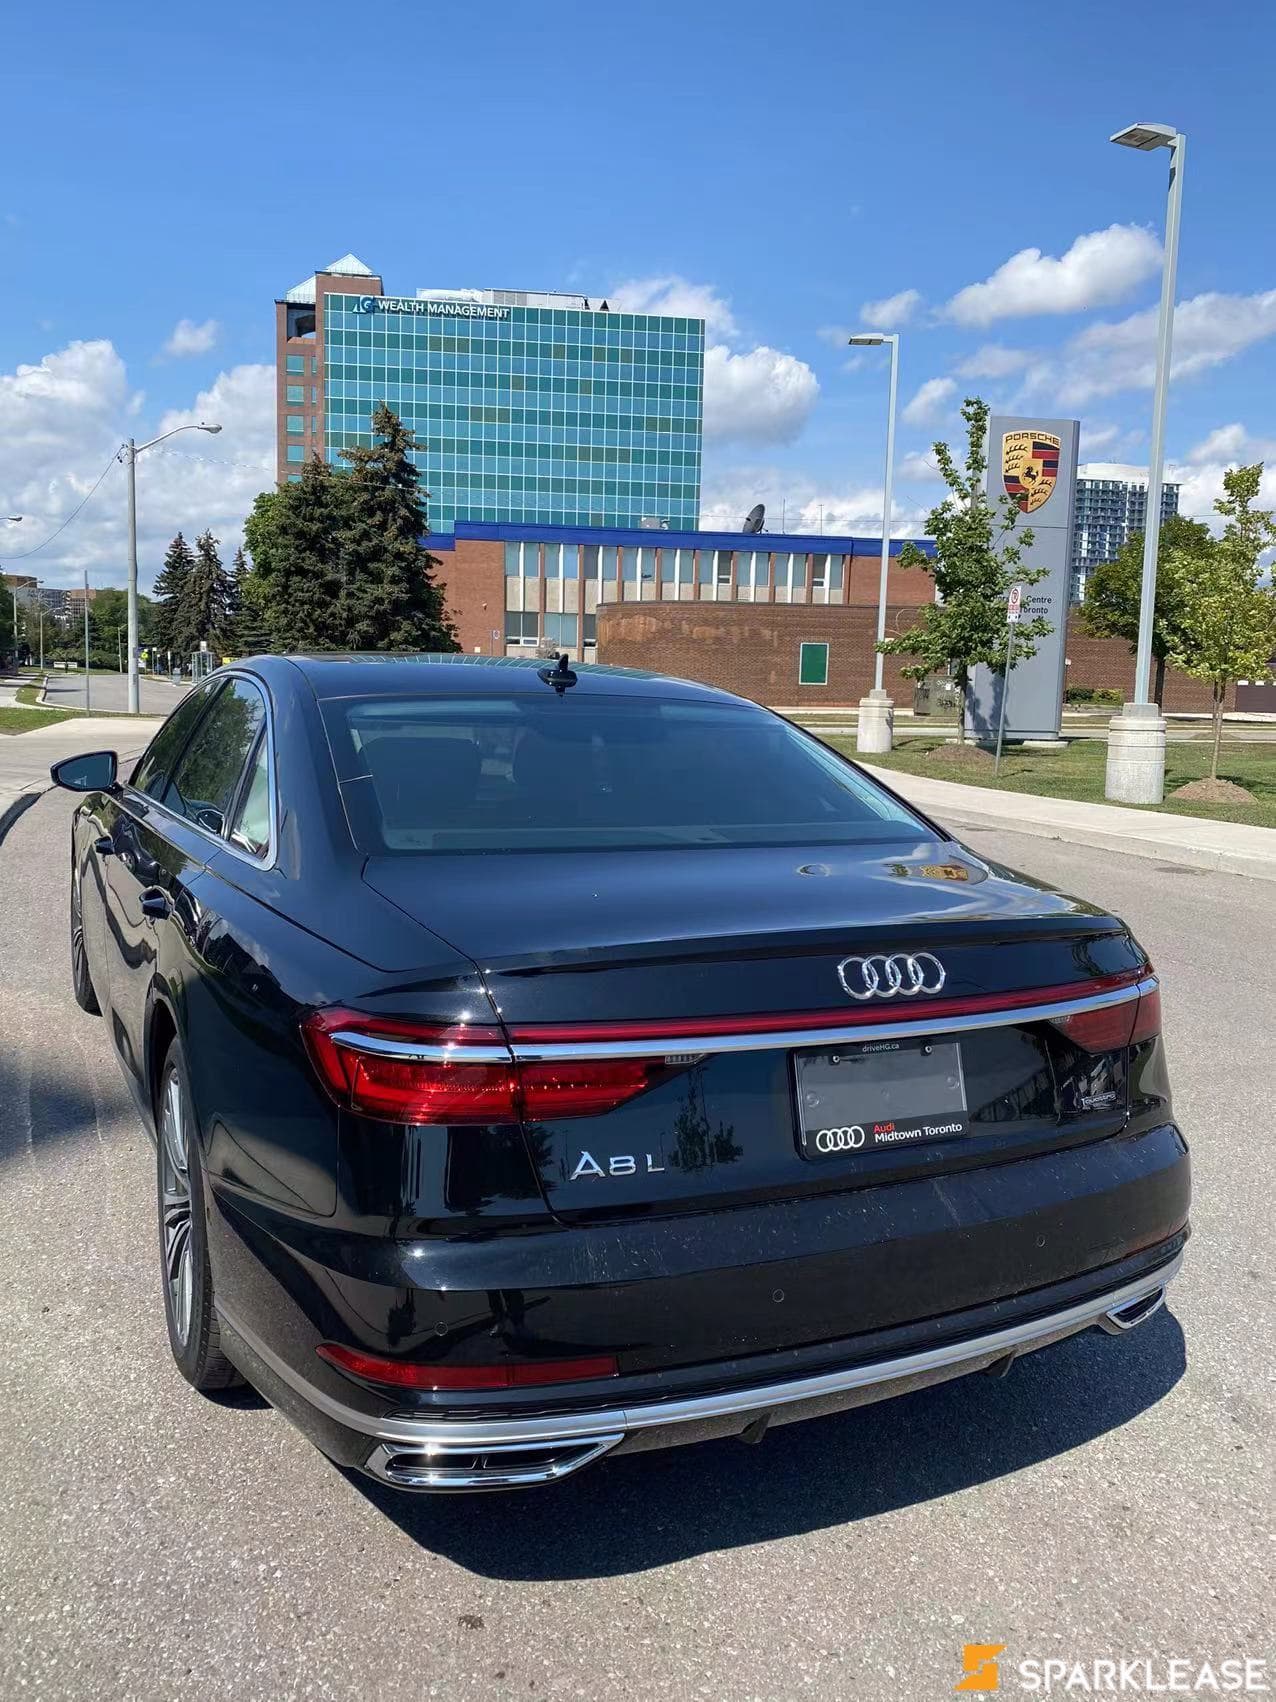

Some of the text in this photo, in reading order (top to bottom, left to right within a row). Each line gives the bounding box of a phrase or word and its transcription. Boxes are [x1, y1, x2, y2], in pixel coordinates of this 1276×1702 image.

[378, 300, 424, 313] WEALTH
[427, 303, 509, 318] MANAGEMENT
[1005, 432, 1060, 446] PORSCHE
[1026, 595, 1052, 604] Centre
[873, 1122, 895, 1134] Audi
[874, 1123, 963, 1143] Midtown Toronto
